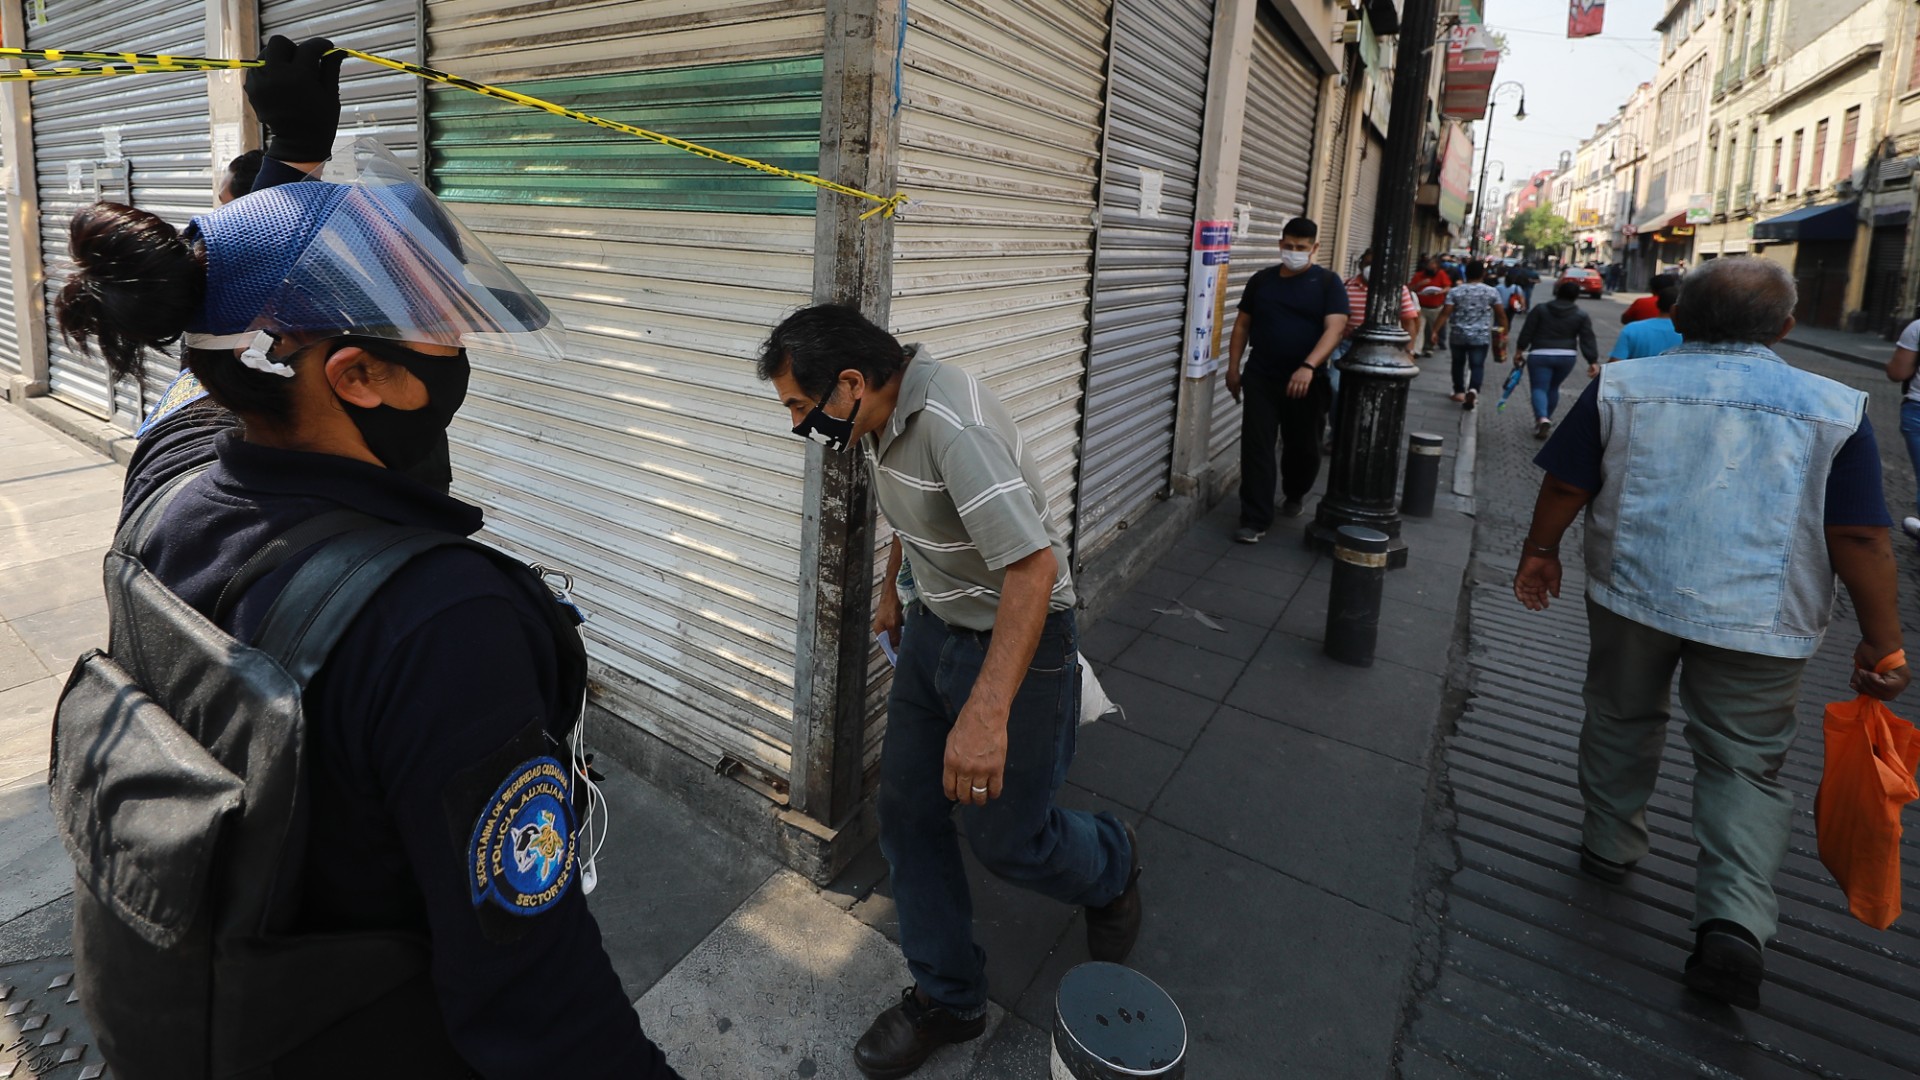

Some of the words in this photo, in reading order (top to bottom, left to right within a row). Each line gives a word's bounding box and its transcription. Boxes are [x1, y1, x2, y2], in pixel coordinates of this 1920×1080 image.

[491, 801, 505, 818] DE
[501, 765, 542, 803] SEGURIDAD
[492, 808, 520, 876] POLICIA
[520, 783, 565, 803] AUXILIAR
